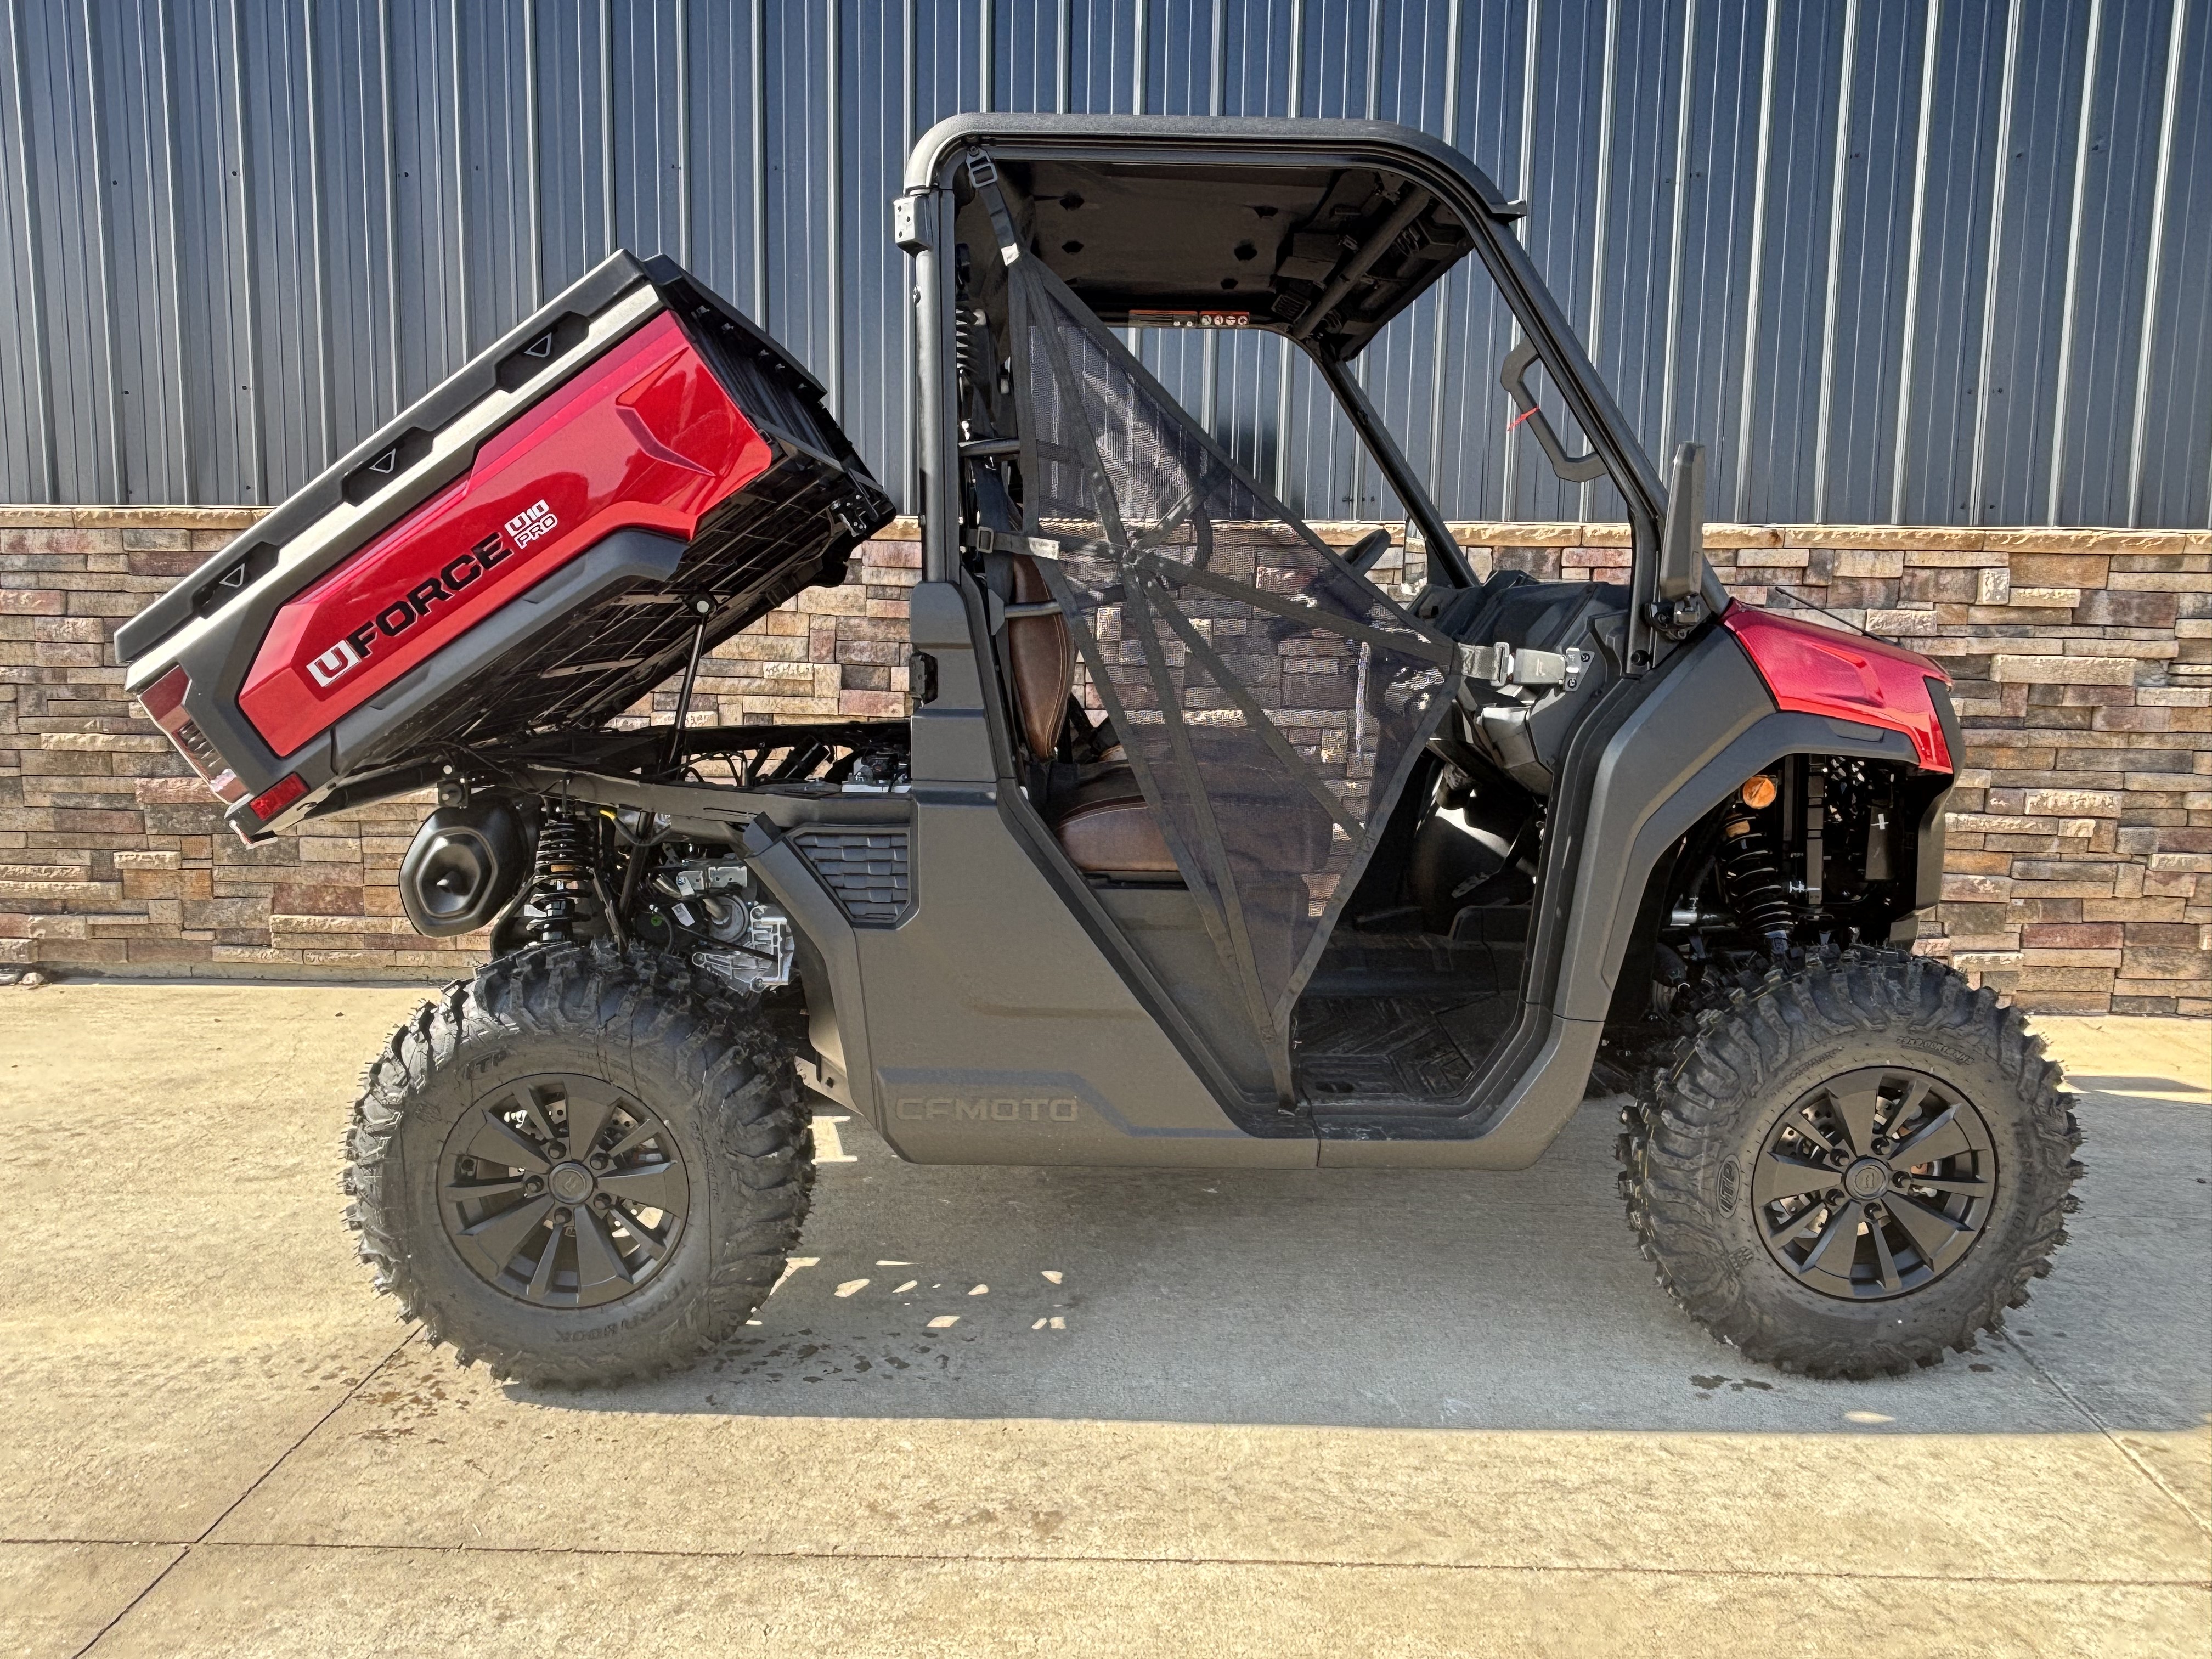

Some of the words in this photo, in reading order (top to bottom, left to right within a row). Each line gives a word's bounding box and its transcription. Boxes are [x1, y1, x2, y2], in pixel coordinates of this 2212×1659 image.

[504, 499, 550, 537] U10
[514, 513, 559, 550] PRO
[306, 531, 515, 688] UFORCE
[895, 1098, 1078, 1122] CFMOTO
[1719, 1161, 1735, 1214] ITP
